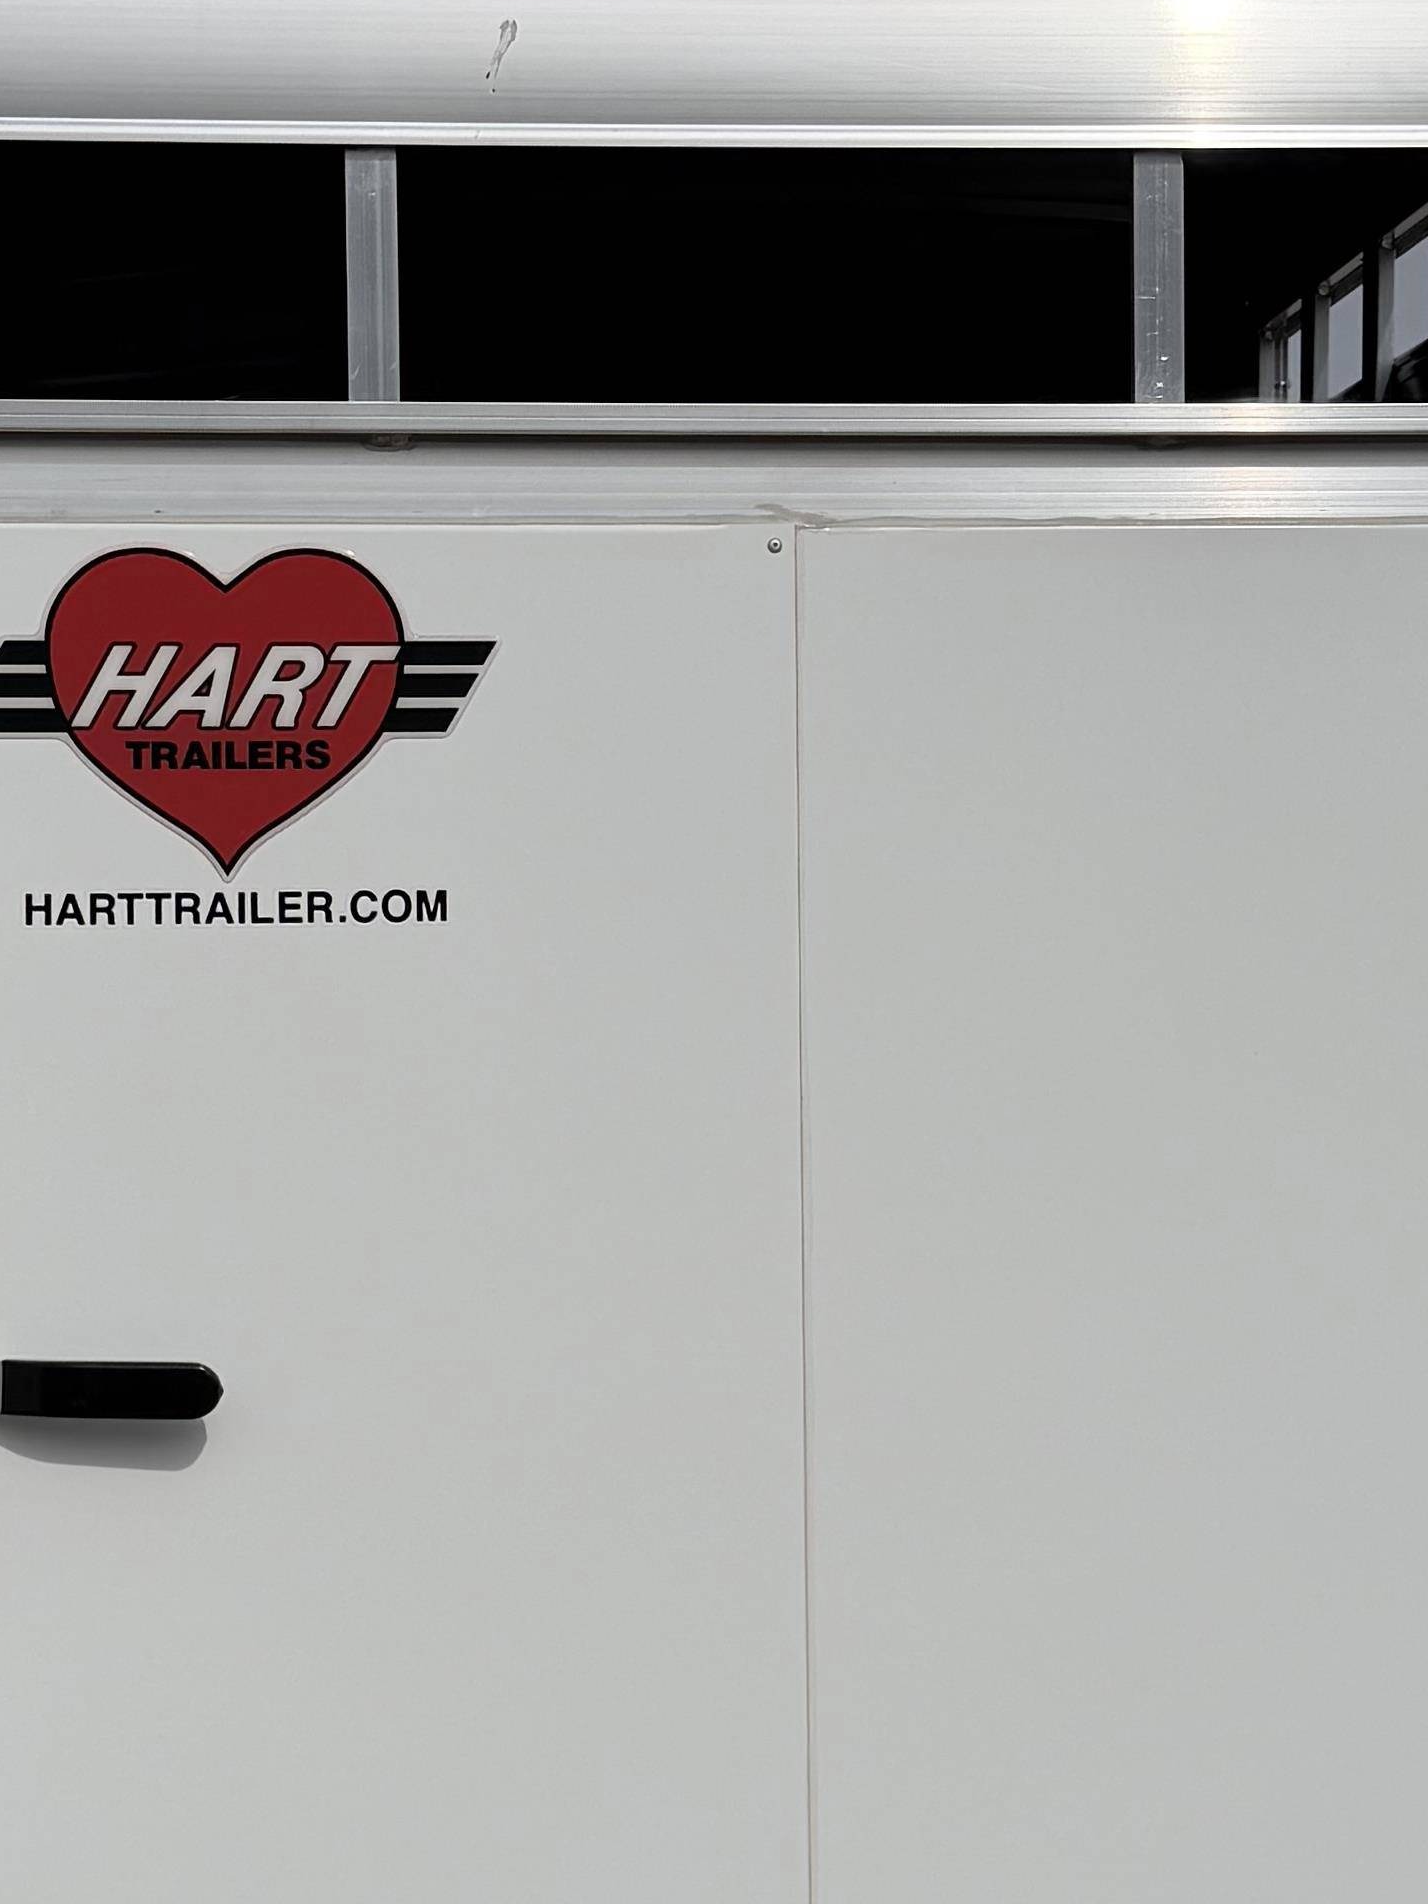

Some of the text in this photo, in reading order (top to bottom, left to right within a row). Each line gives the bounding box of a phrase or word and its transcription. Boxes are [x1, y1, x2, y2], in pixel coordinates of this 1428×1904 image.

[70, 643, 403, 730] HART
[125, 739, 332, 771] TRAILERS
[24, 888, 450, 927] HARTTRAILER.COM
